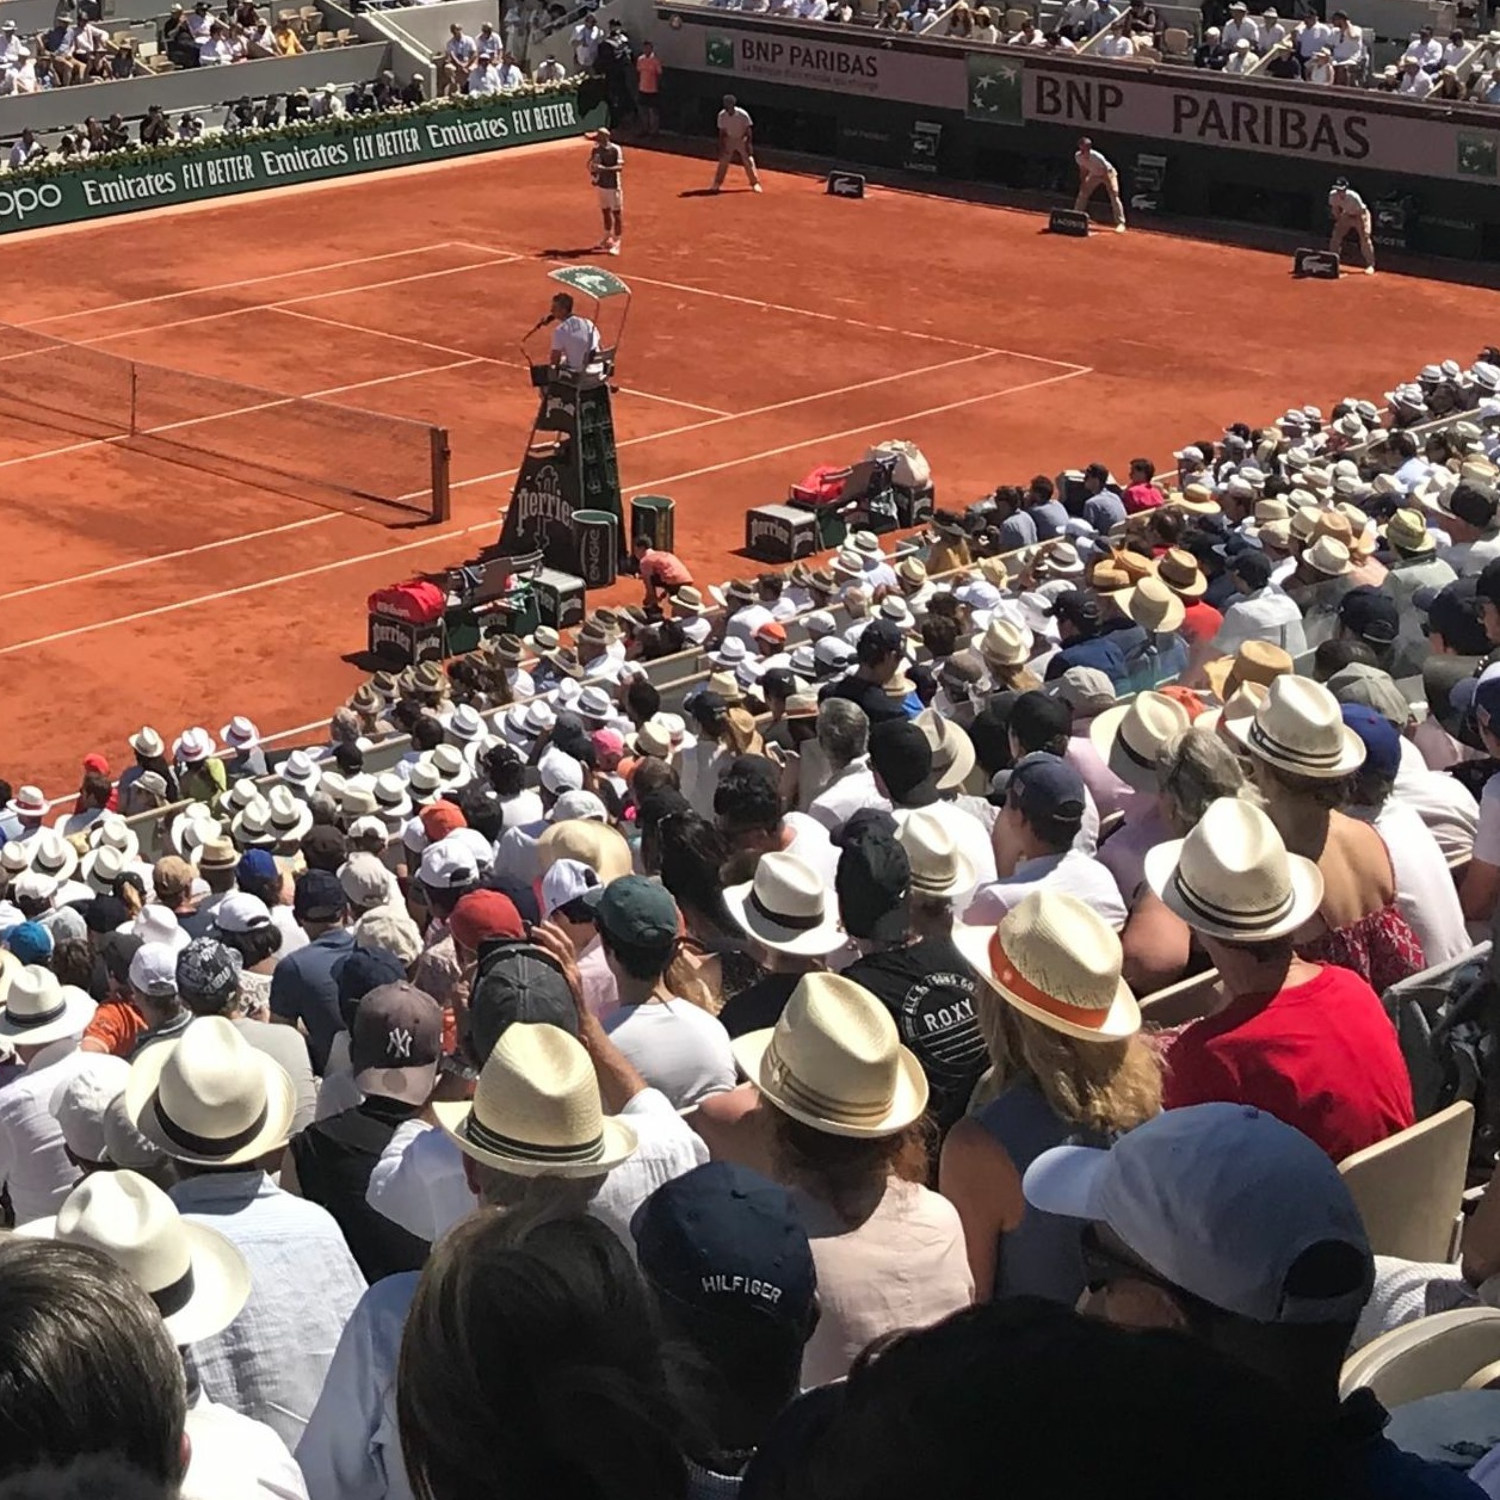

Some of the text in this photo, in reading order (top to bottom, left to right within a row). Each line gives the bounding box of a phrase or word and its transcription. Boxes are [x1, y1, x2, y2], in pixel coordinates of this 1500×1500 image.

[741, 38, 784, 63] BNP
[789, 45, 878, 78] PARIBAS
[426, 102, 577, 149] Emirates FLY BETTER
[1035, 74, 1370, 160] BNP PARIBAS
[260, 127, 421, 176] Emirates FLY BETTER
[82, 154, 255, 206] Emirates FLY BETTER
[701, 1274, 783, 1304] HILFIGER
